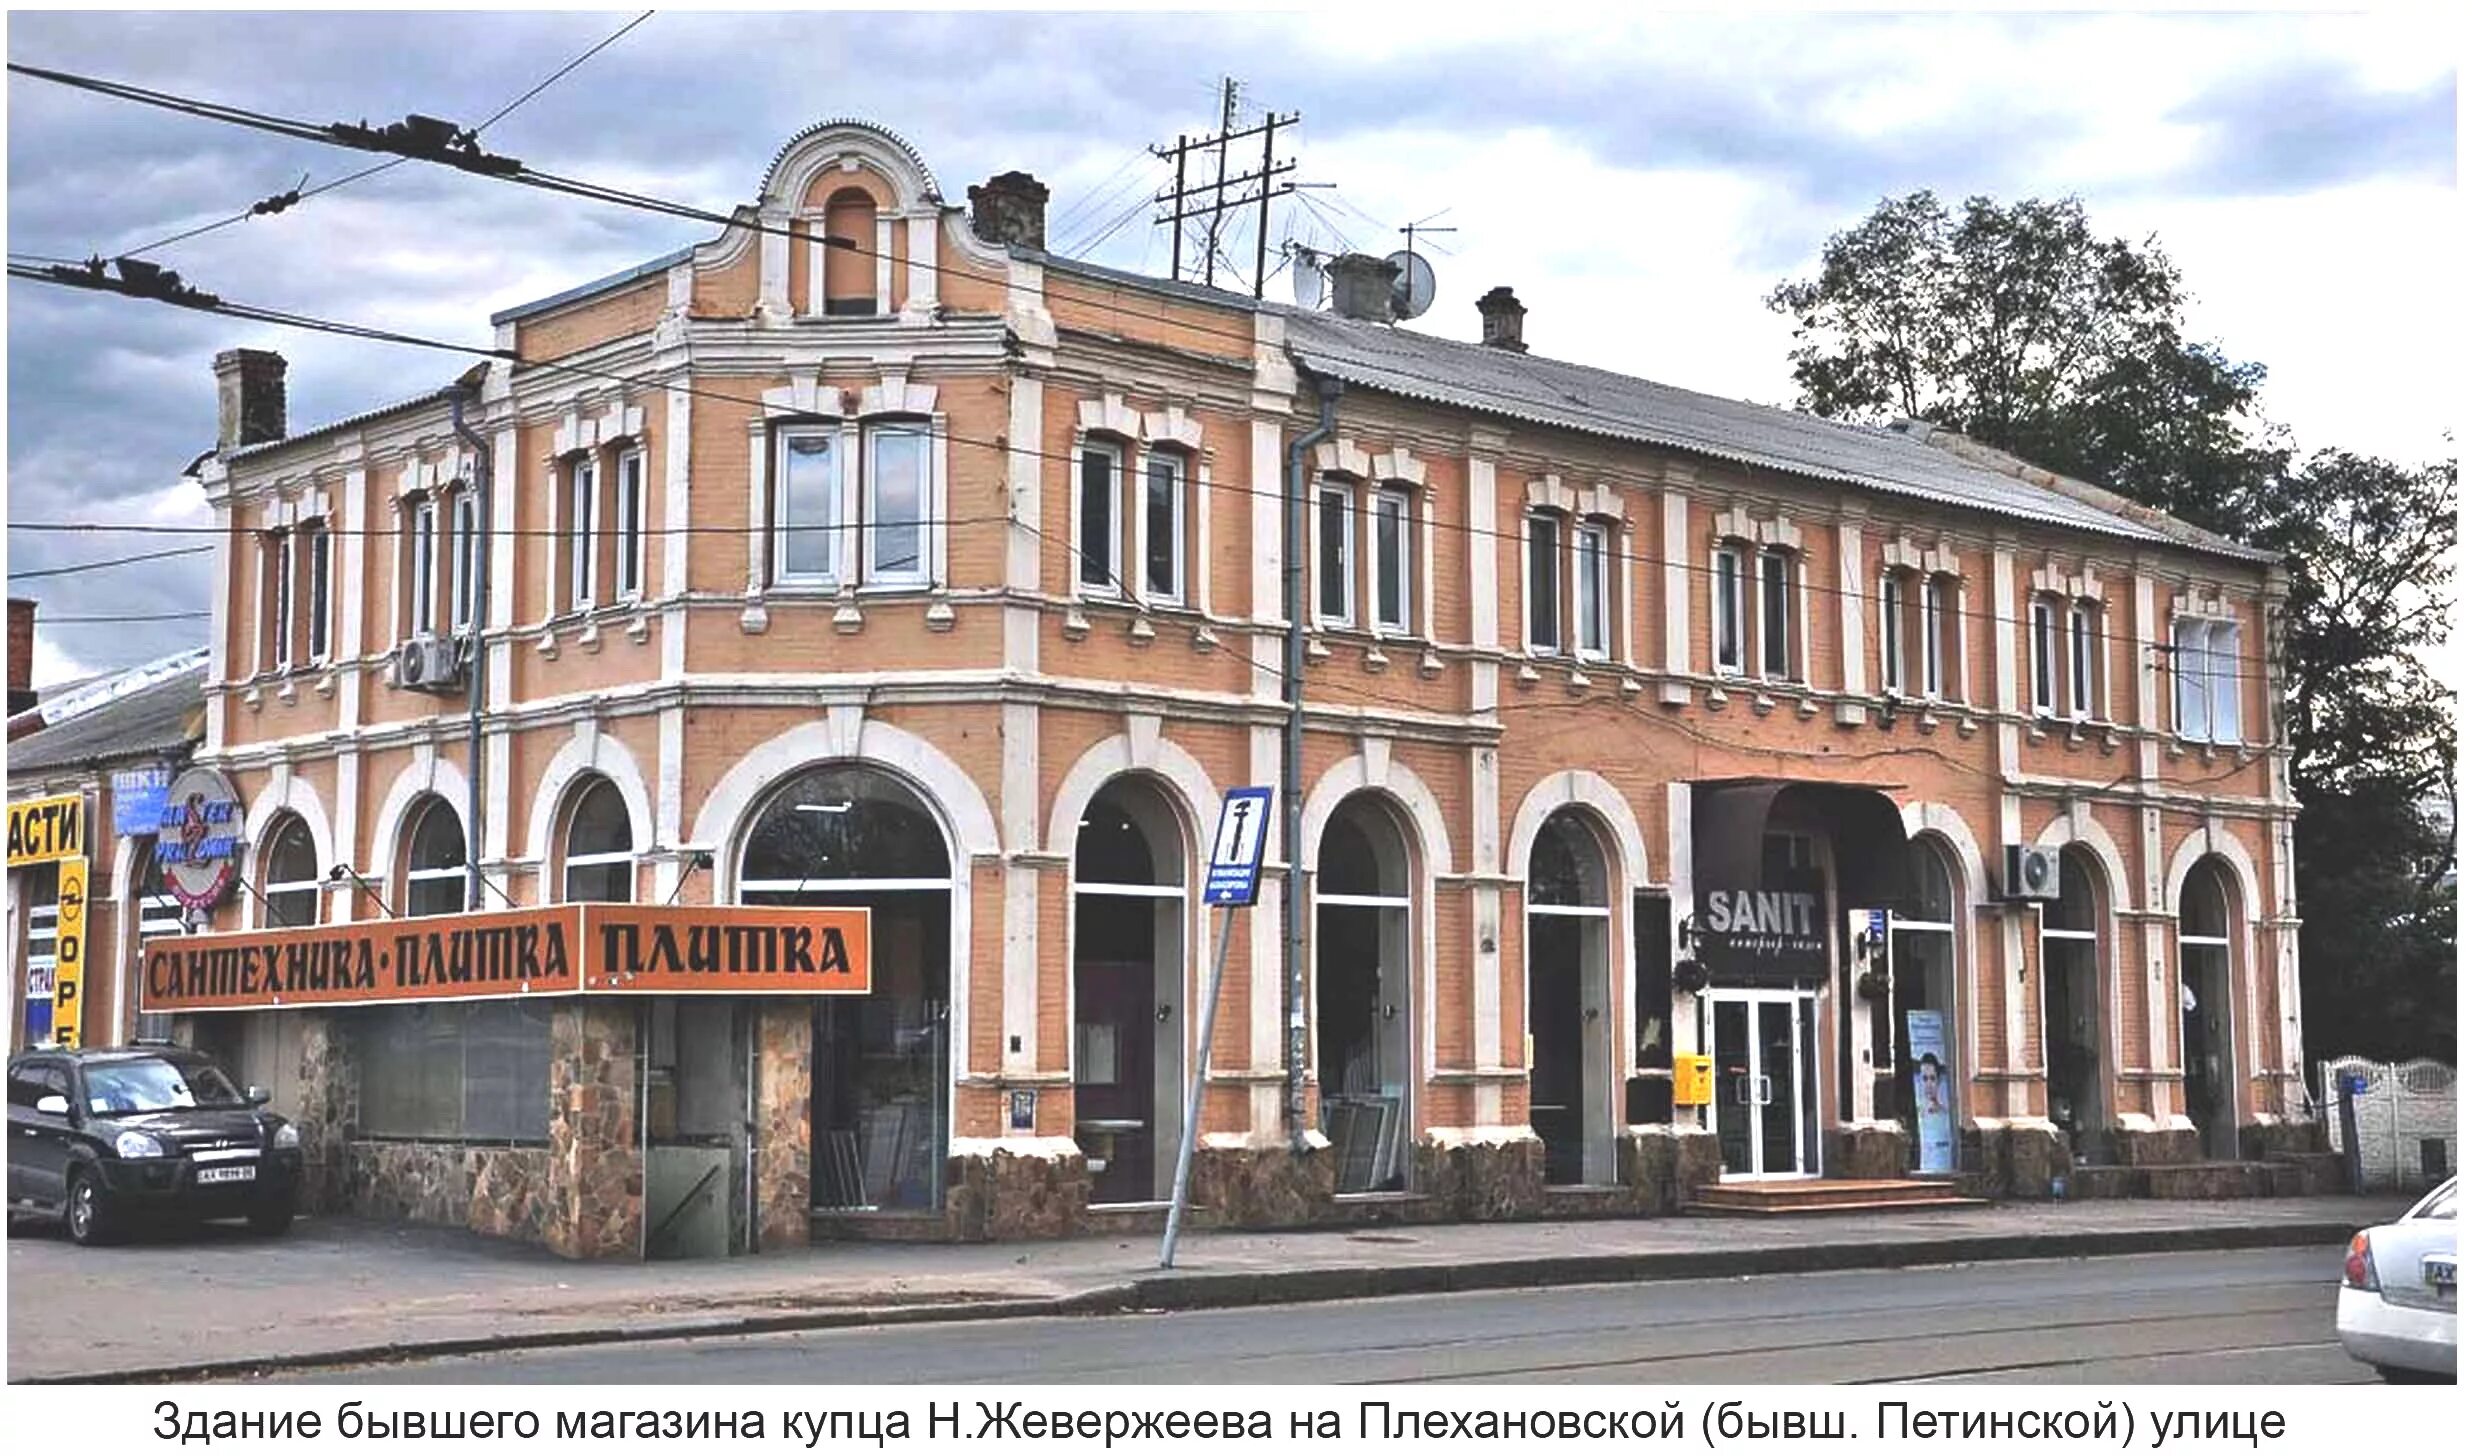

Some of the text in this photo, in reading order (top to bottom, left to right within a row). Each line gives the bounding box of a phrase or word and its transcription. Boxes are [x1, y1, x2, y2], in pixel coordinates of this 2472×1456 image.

[7, 802, 77, 858] АСТИ
[1708, 890, 1815, 935] SANIT
[149, 922, 569, 998] САНТЕХНИКА ПЛИТКА
[600, 923, 851, 973] ПЛИТКА
